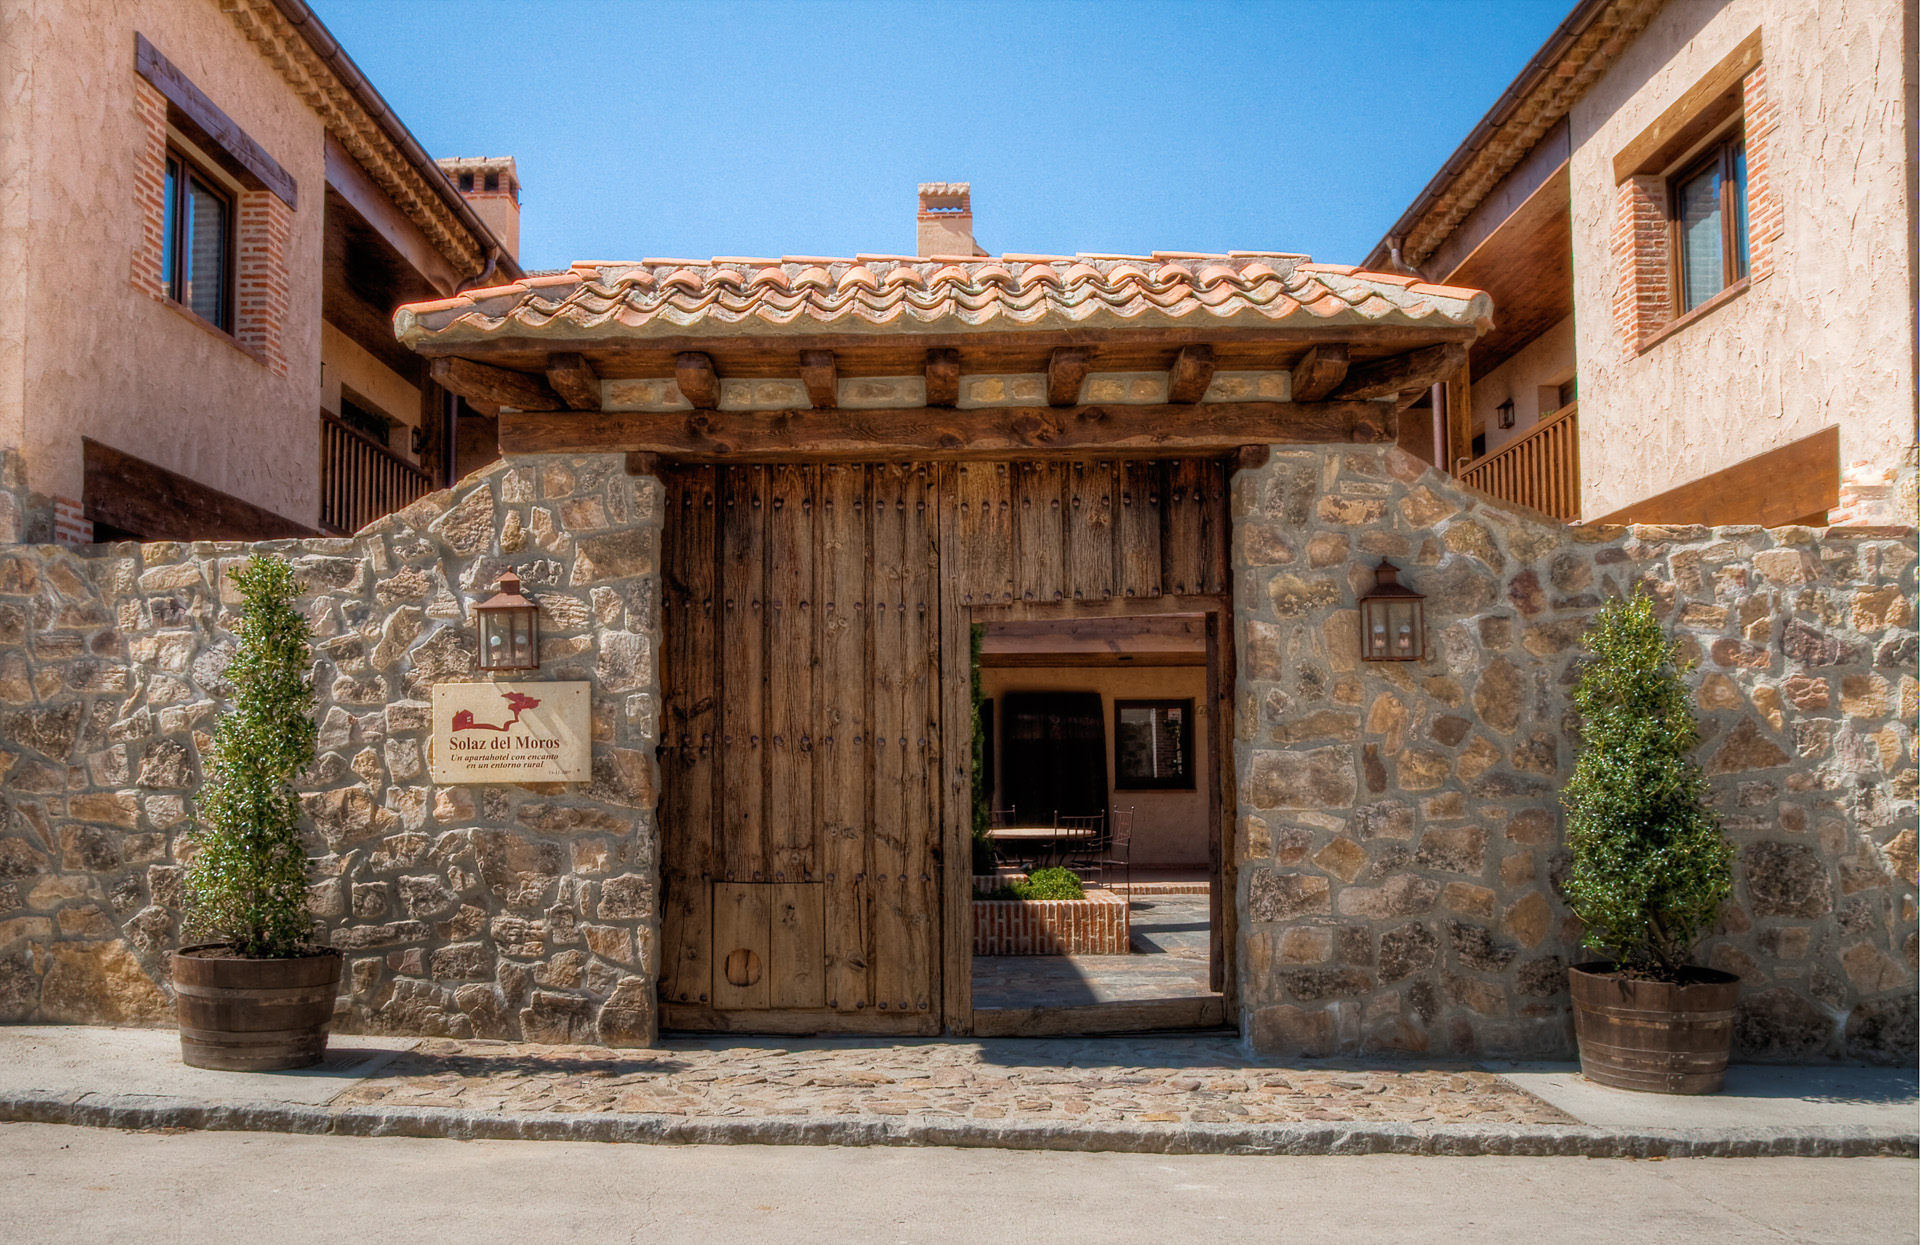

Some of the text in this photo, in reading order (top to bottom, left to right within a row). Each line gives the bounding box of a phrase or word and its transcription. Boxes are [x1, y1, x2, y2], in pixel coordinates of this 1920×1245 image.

[450, 736, 560, 750] Solaz del Moros
[451, 754, 462, 762] Un
[464, 754, 510, 762] apartahotel
